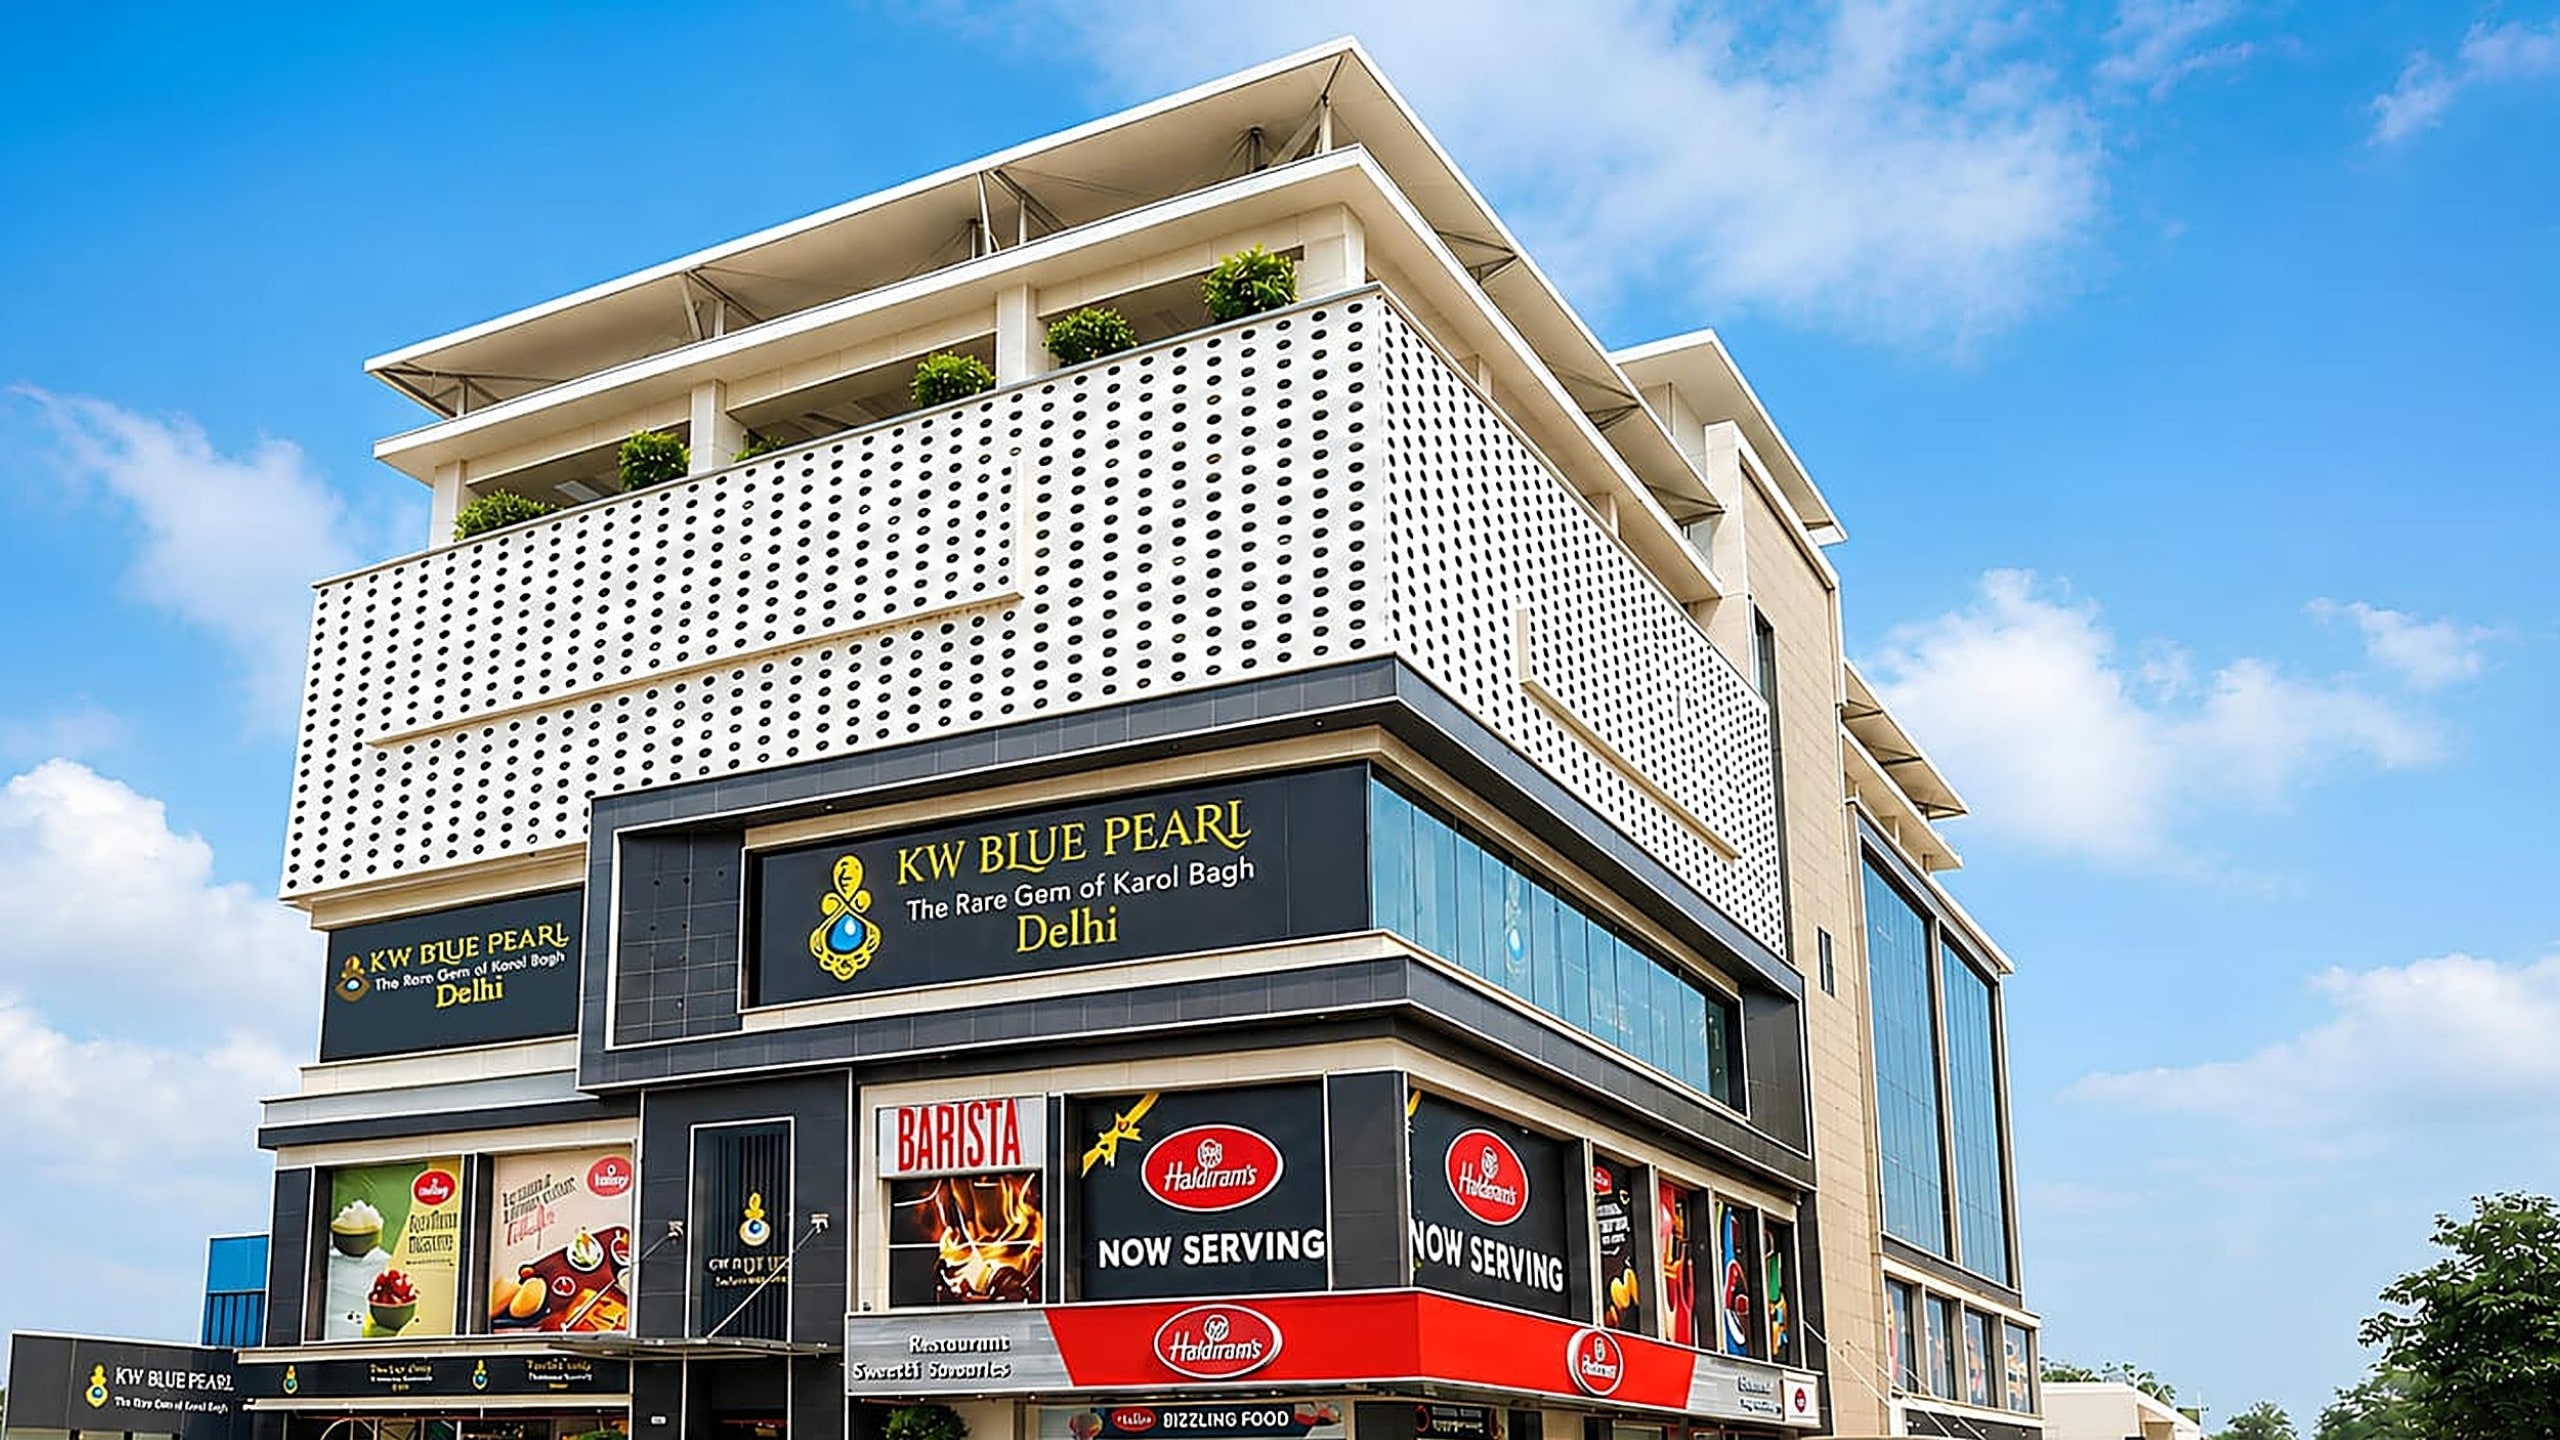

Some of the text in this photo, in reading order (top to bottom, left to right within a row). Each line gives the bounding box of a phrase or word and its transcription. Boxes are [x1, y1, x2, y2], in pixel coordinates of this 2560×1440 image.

[897, 800, 1252, 885] KW BLUE PEARL
[907, 855, 1254, 921] The Rare Gem of Karol Bagh
[370, 922, 570, 972] KW BLUE PEARL
[1017, 905, 1118, 952] Delhi
[435, 975, 503, 1009] Delhi
[898, 1097, 1022, 1171] BARISTA
[1099, 1229, 1325, 1268] NOW SERVING
[1409, 1218, 1564, 1292] NOW SERVING
[115, 1367, 235, 1391] KW BLUE PEARL
[1241, 1410, 1289, 1427] FOOD
